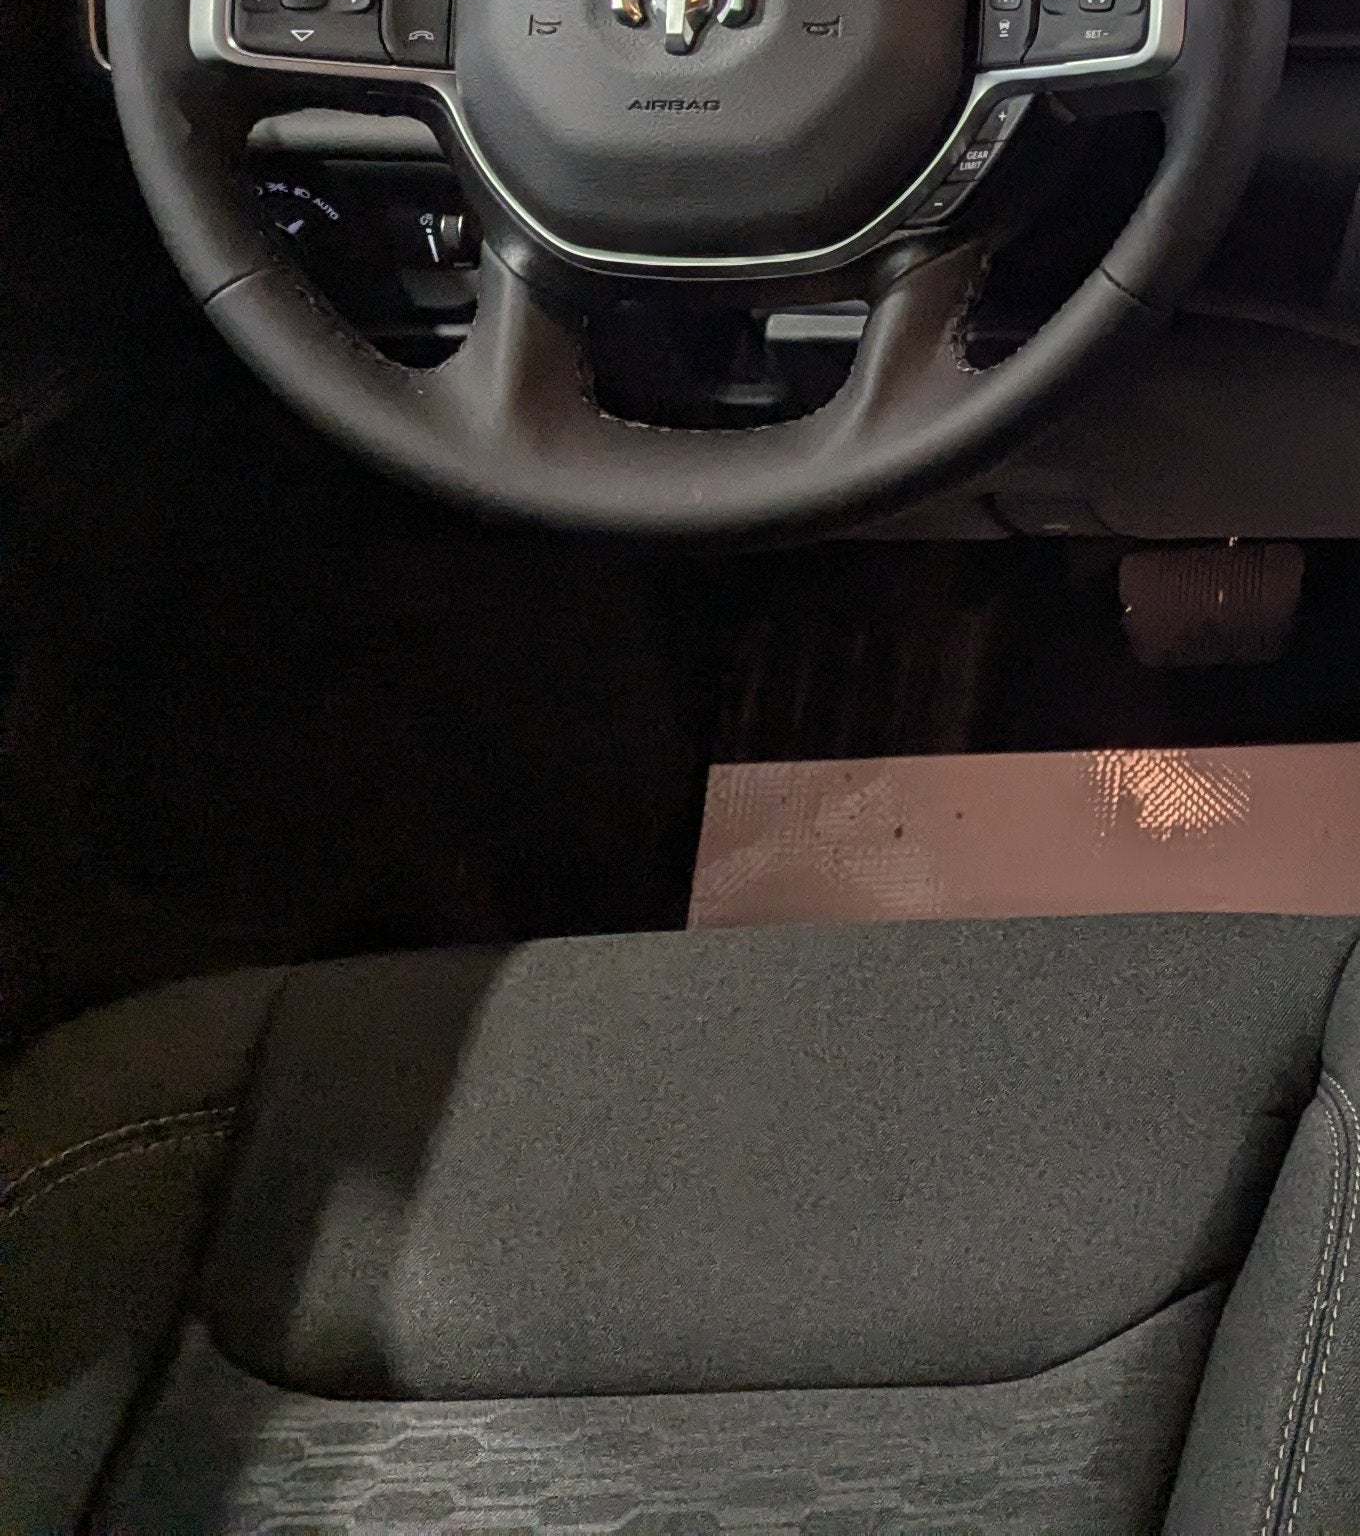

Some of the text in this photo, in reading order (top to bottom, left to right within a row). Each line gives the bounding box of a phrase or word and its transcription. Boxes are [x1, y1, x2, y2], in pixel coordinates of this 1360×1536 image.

[628, 99, 720, 111] AIRBAG
[966, 150, 989, 160] GEAR
[312, 197, 340, 221] AUTO
